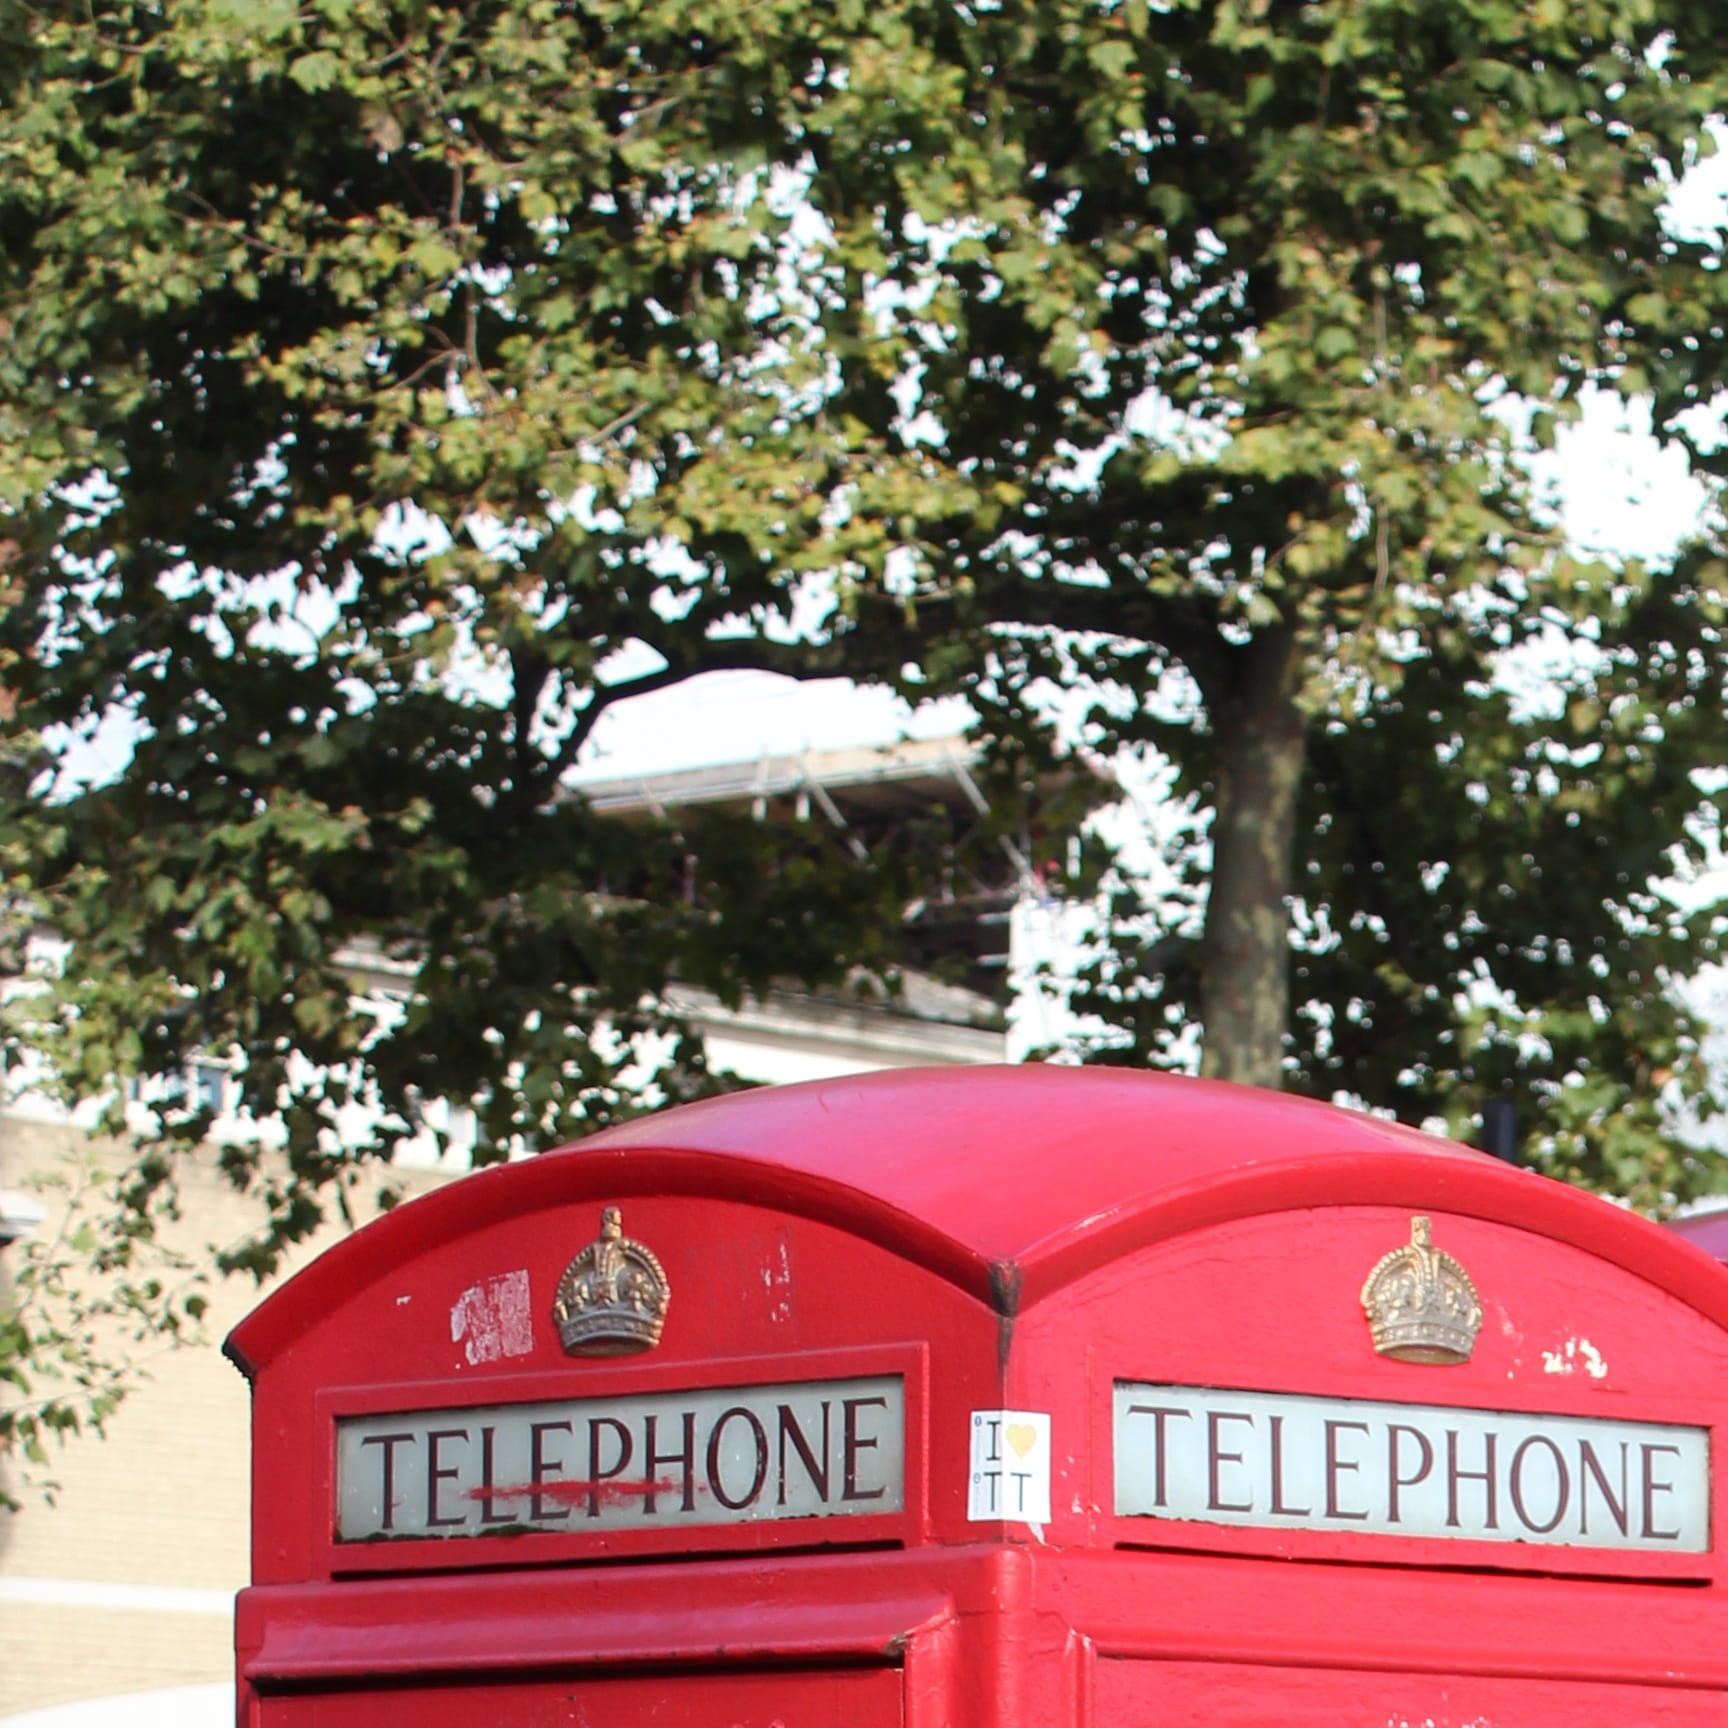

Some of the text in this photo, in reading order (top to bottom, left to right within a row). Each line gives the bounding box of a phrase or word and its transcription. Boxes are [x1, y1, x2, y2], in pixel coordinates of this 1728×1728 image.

[360, 1396, 888, 1530] TELEPHONE
[987, 1421, 1002, 1461] I
[1126, 1404, 1682, 1541] TELEPHONE
[983, 1471, 1033, 1513] TT
